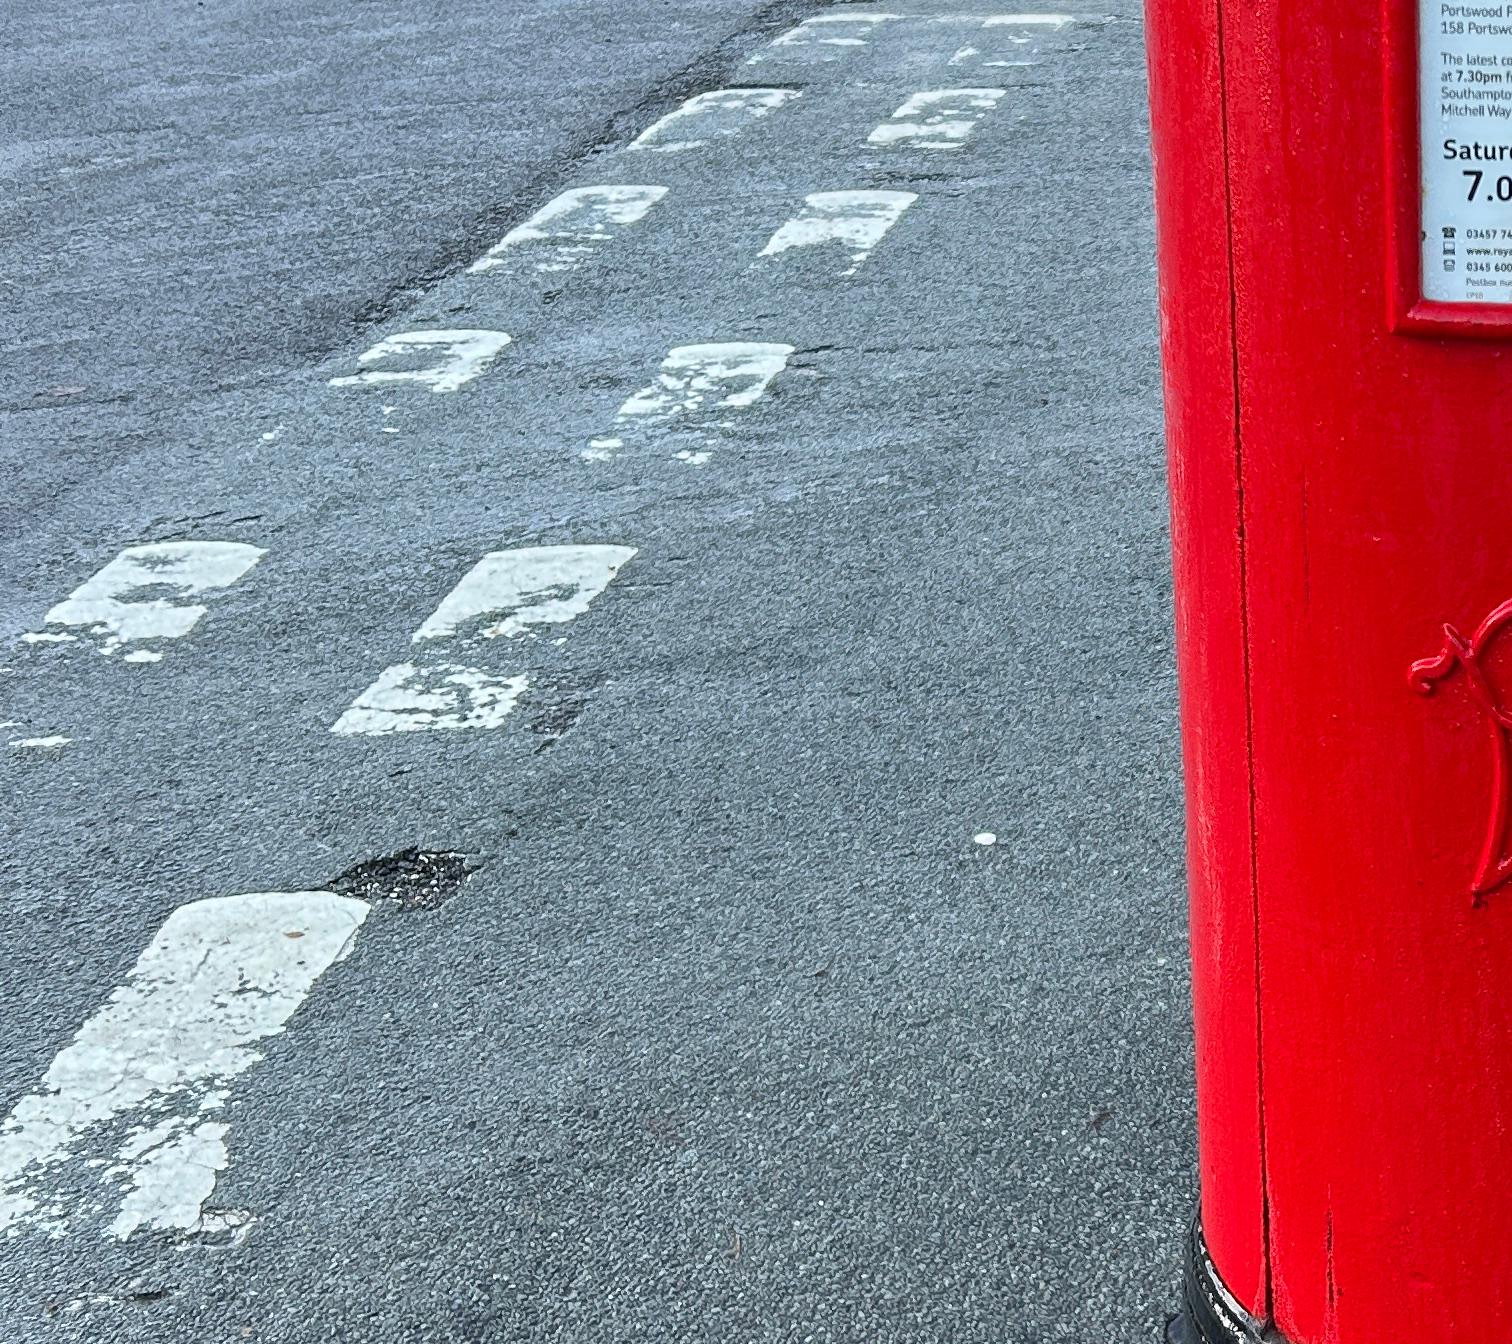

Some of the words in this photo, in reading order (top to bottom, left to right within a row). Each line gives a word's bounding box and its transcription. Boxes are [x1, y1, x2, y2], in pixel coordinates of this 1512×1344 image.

[1441, 3, 1502, 18] Portswood
[1440, 21, 1464, 35] 158
[1441, 52, 1463, 65] The
[1466, 53, 1498, 66] latest
[1441, 71, 1453, 82] at
[1456, 70, 1502, 86] 7.30pm
[1441, 104, 1485, 117] Mitchell
[1487, 105, 1512, 120] Way
[1466, 229, 1498, 240] 03457
[1466, 262, 1491, 273] 0345
